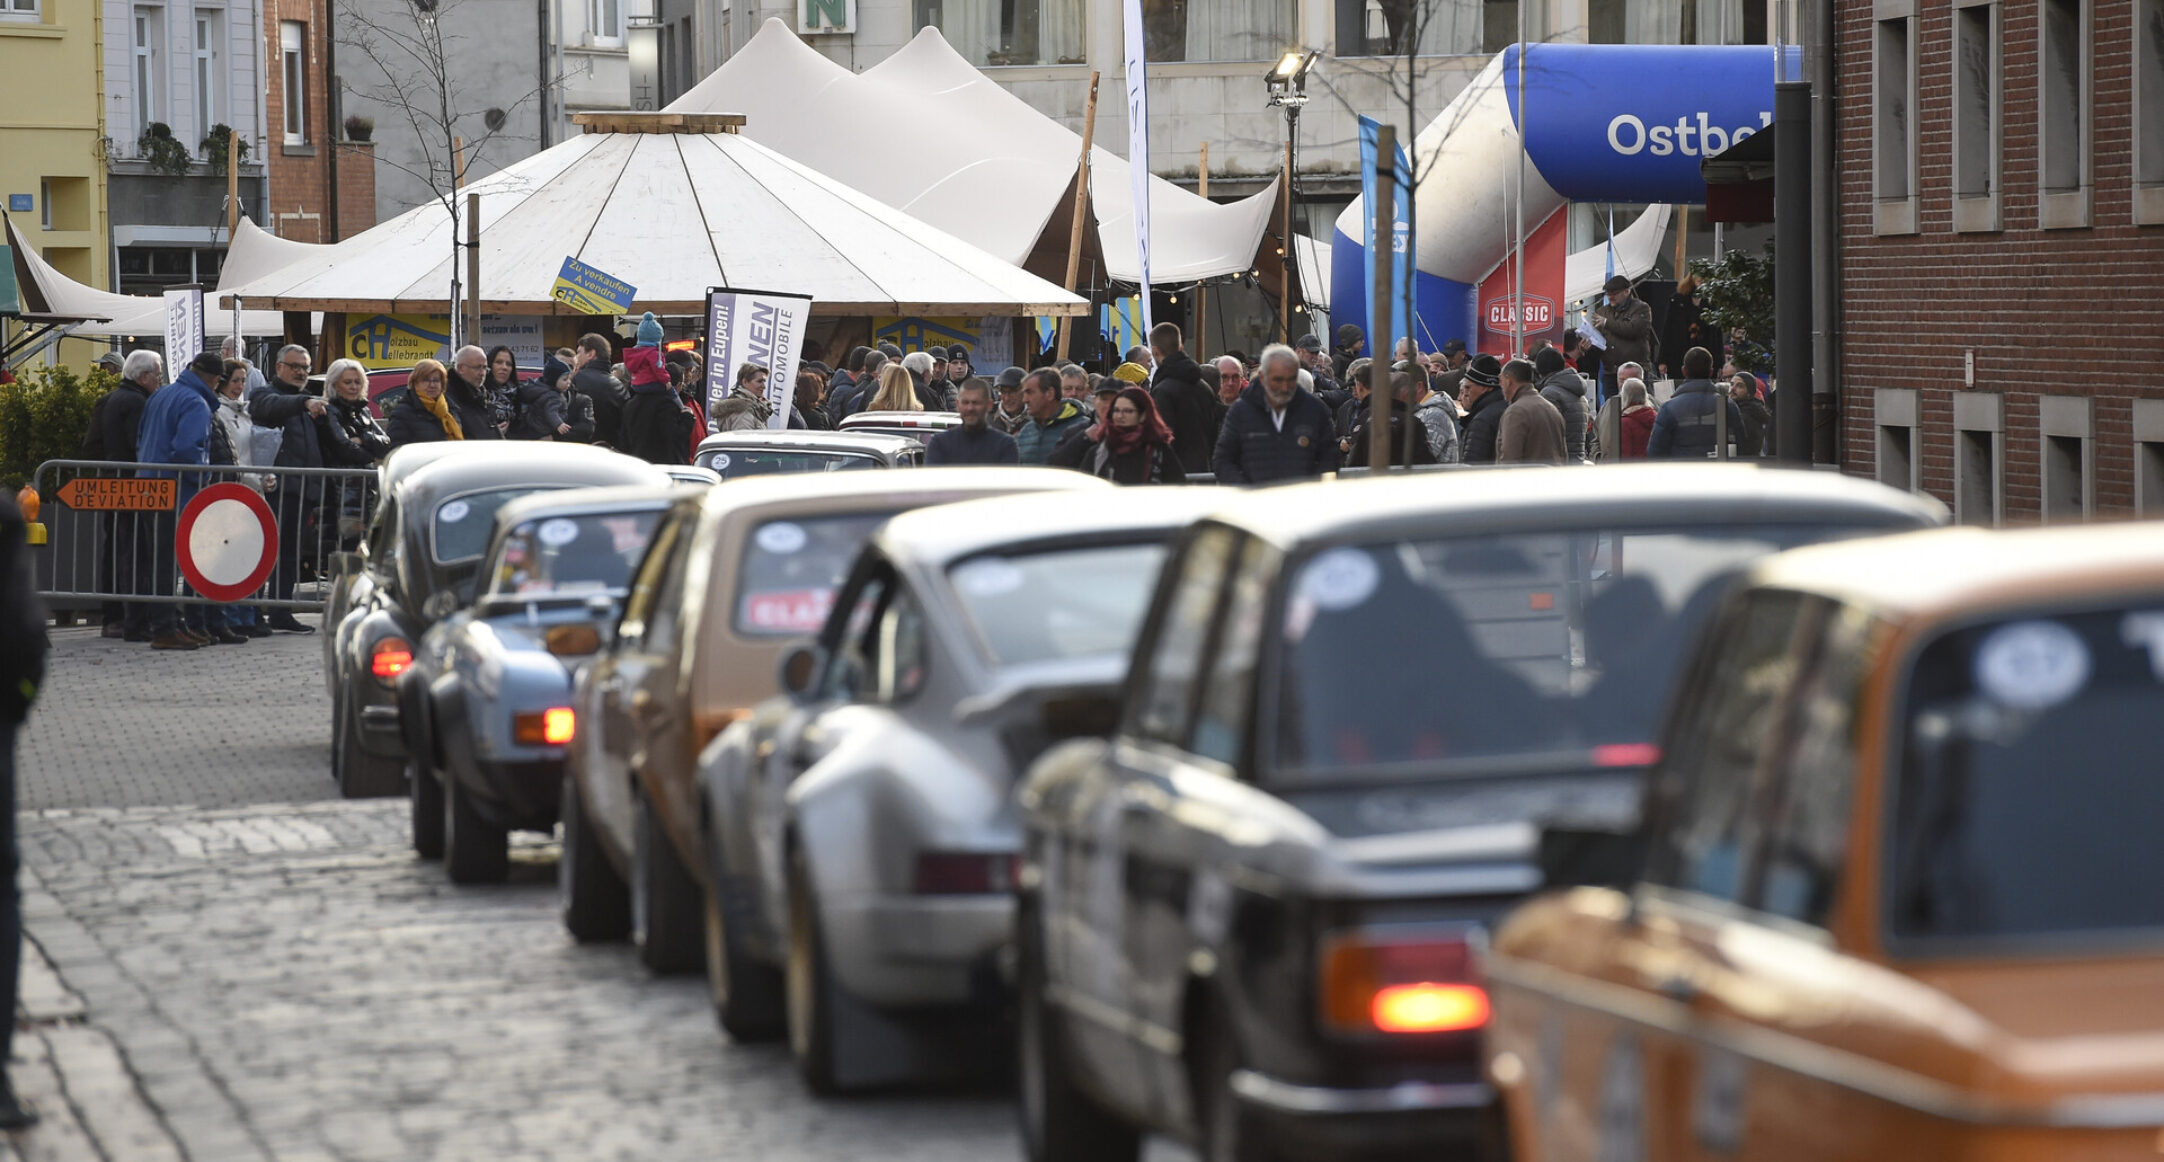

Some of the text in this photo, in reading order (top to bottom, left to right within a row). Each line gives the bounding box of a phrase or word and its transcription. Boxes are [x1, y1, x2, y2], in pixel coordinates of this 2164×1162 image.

[568, 261, 631, 295] Zu verkaufen
[575, 275, 617, 300] A vendre
[1490, 305, 1549, 323] CLASIC
[711, 304, 730, 359] Eupen!
[710, 363, 725, 378] in
[773, 309, 793, 417] AUTOMOBILE
[715, 456, 728, 465] 25
[75, 481, 169, 494] UMLEITUNG
[74, 495, 169, 508] DEVIATION
